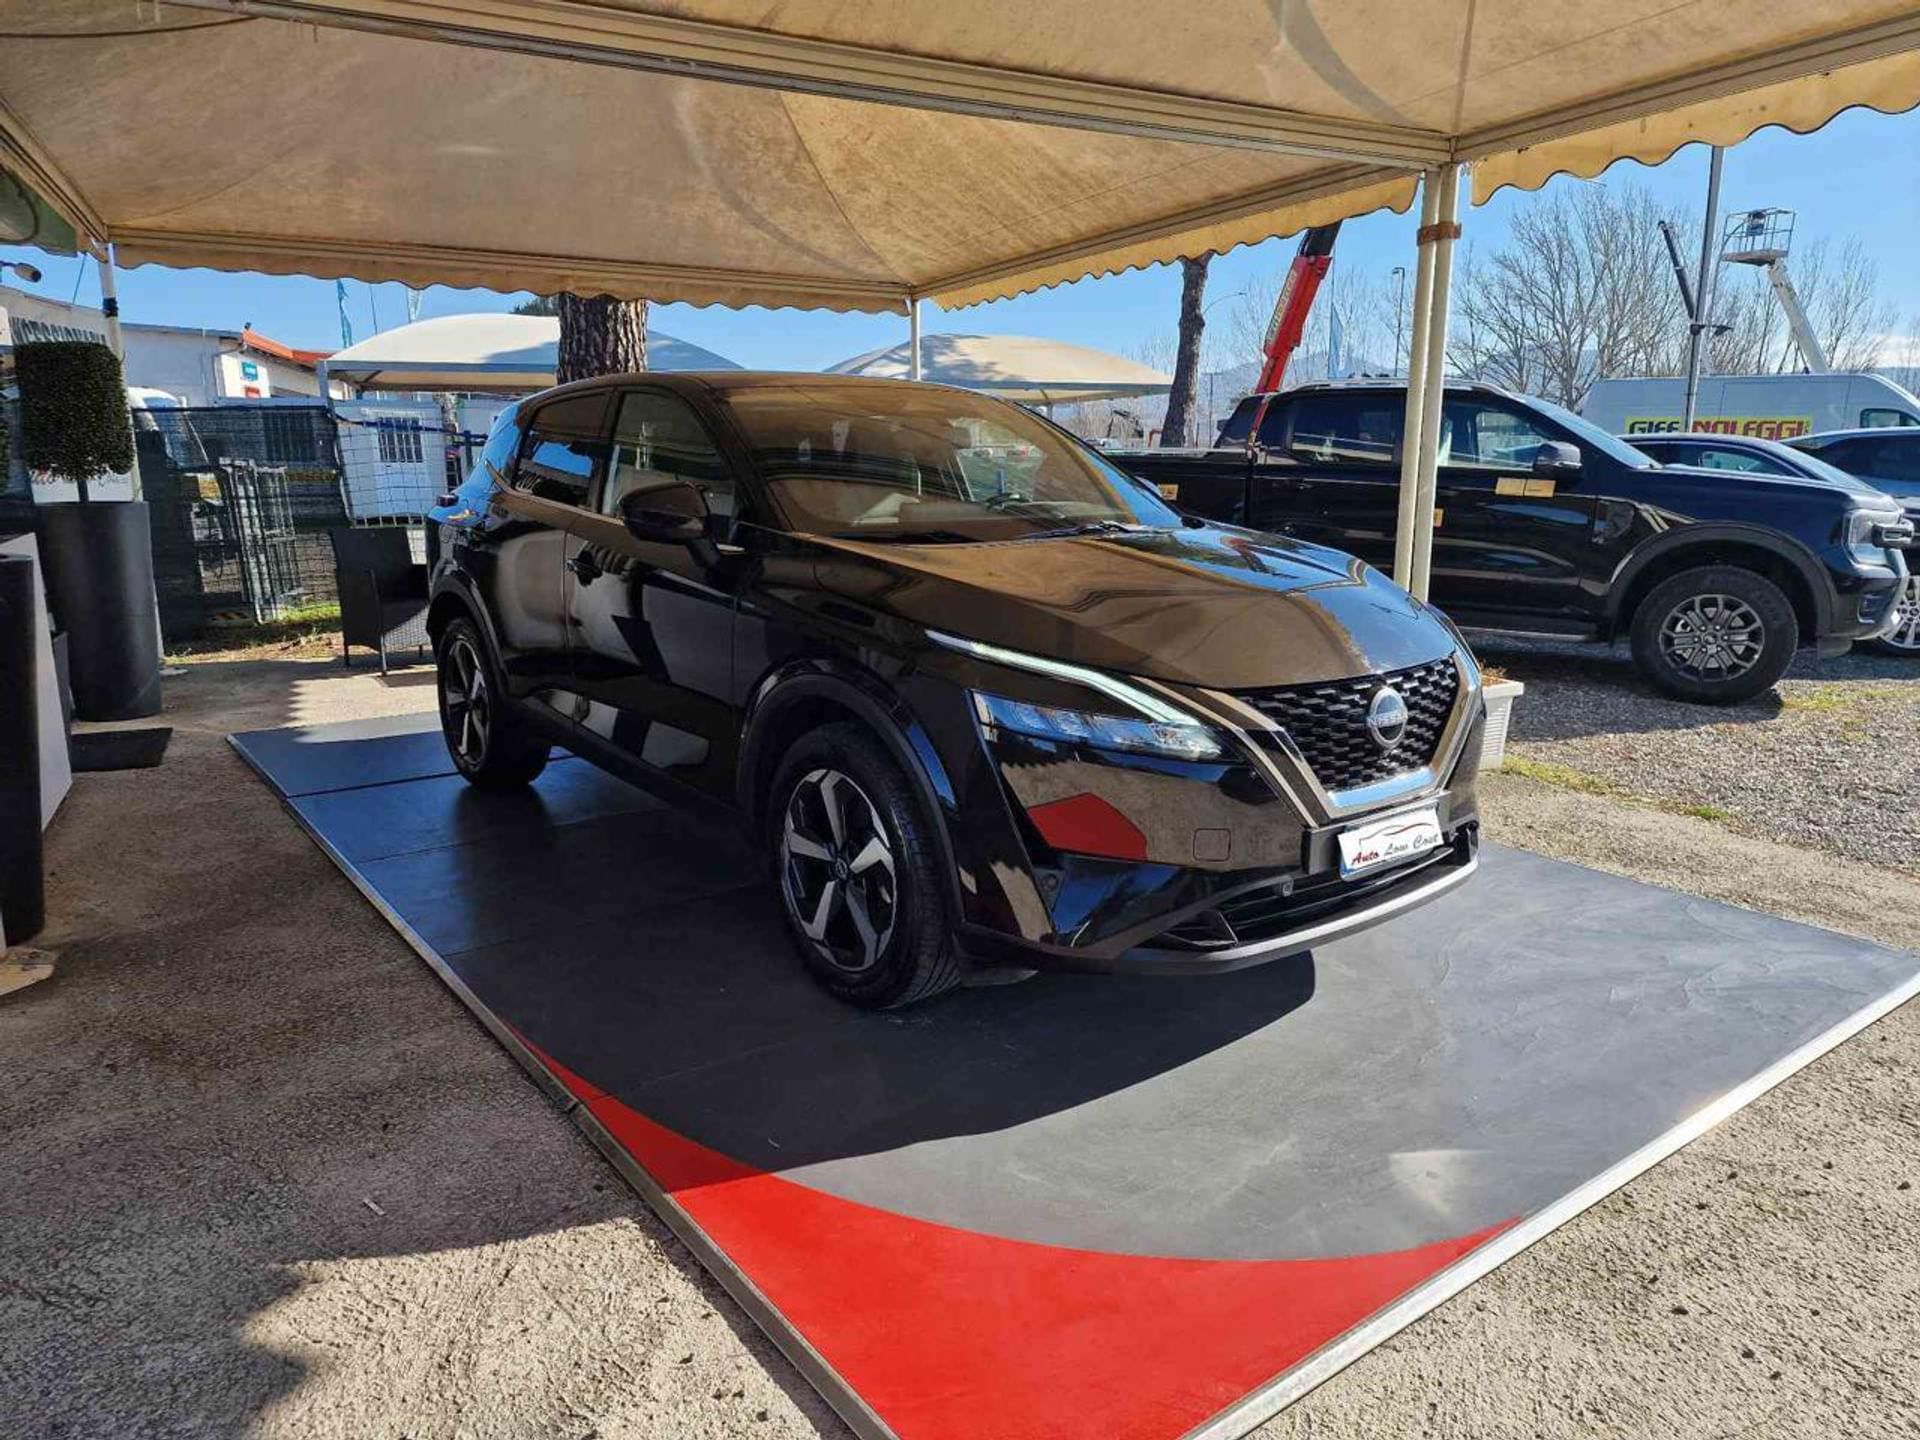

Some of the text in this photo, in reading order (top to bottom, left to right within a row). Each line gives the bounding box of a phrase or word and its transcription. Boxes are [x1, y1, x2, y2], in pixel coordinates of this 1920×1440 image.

[1351, 834, 1439, 866] Auto Low Cost
